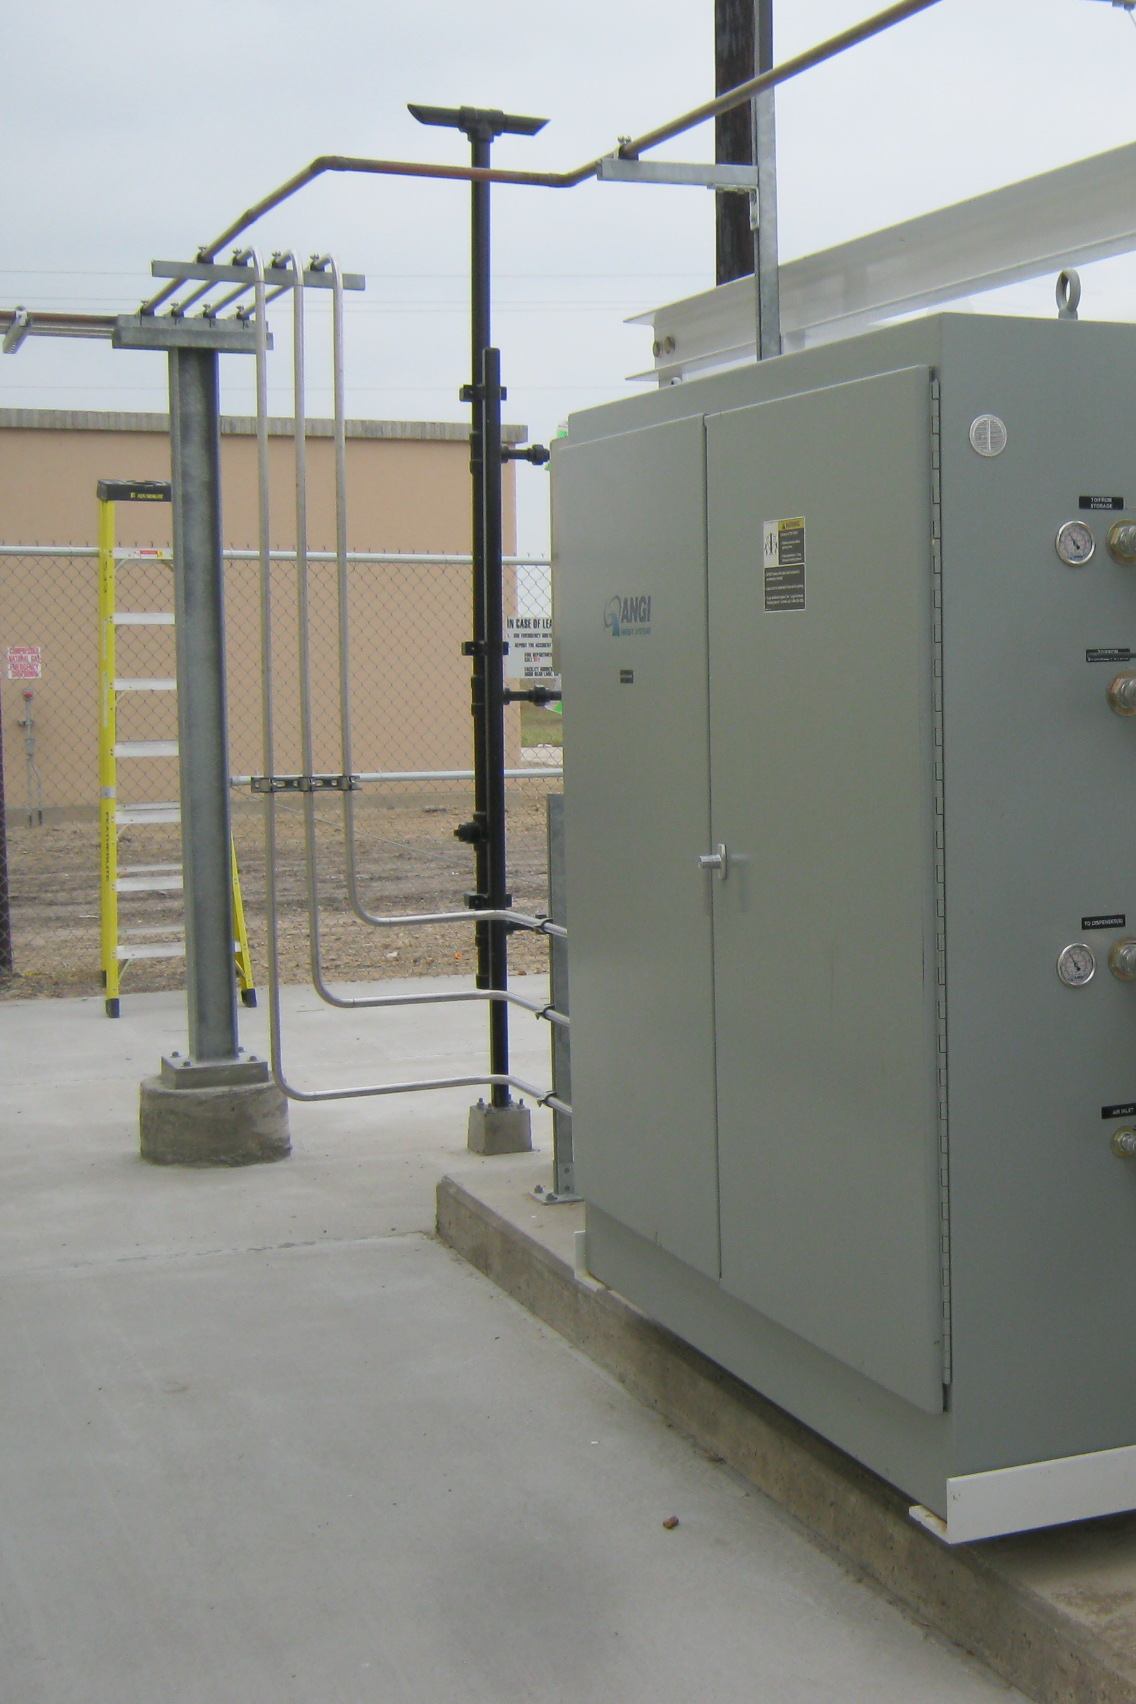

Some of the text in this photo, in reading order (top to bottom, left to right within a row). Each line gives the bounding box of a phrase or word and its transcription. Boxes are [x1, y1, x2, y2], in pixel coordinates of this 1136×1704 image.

[621, 595, 652, 624] ANGI
[507, 618, 514, 629] IN
[516, 618, 532, 629] CASE
[533, 618, 541, 629] OF
